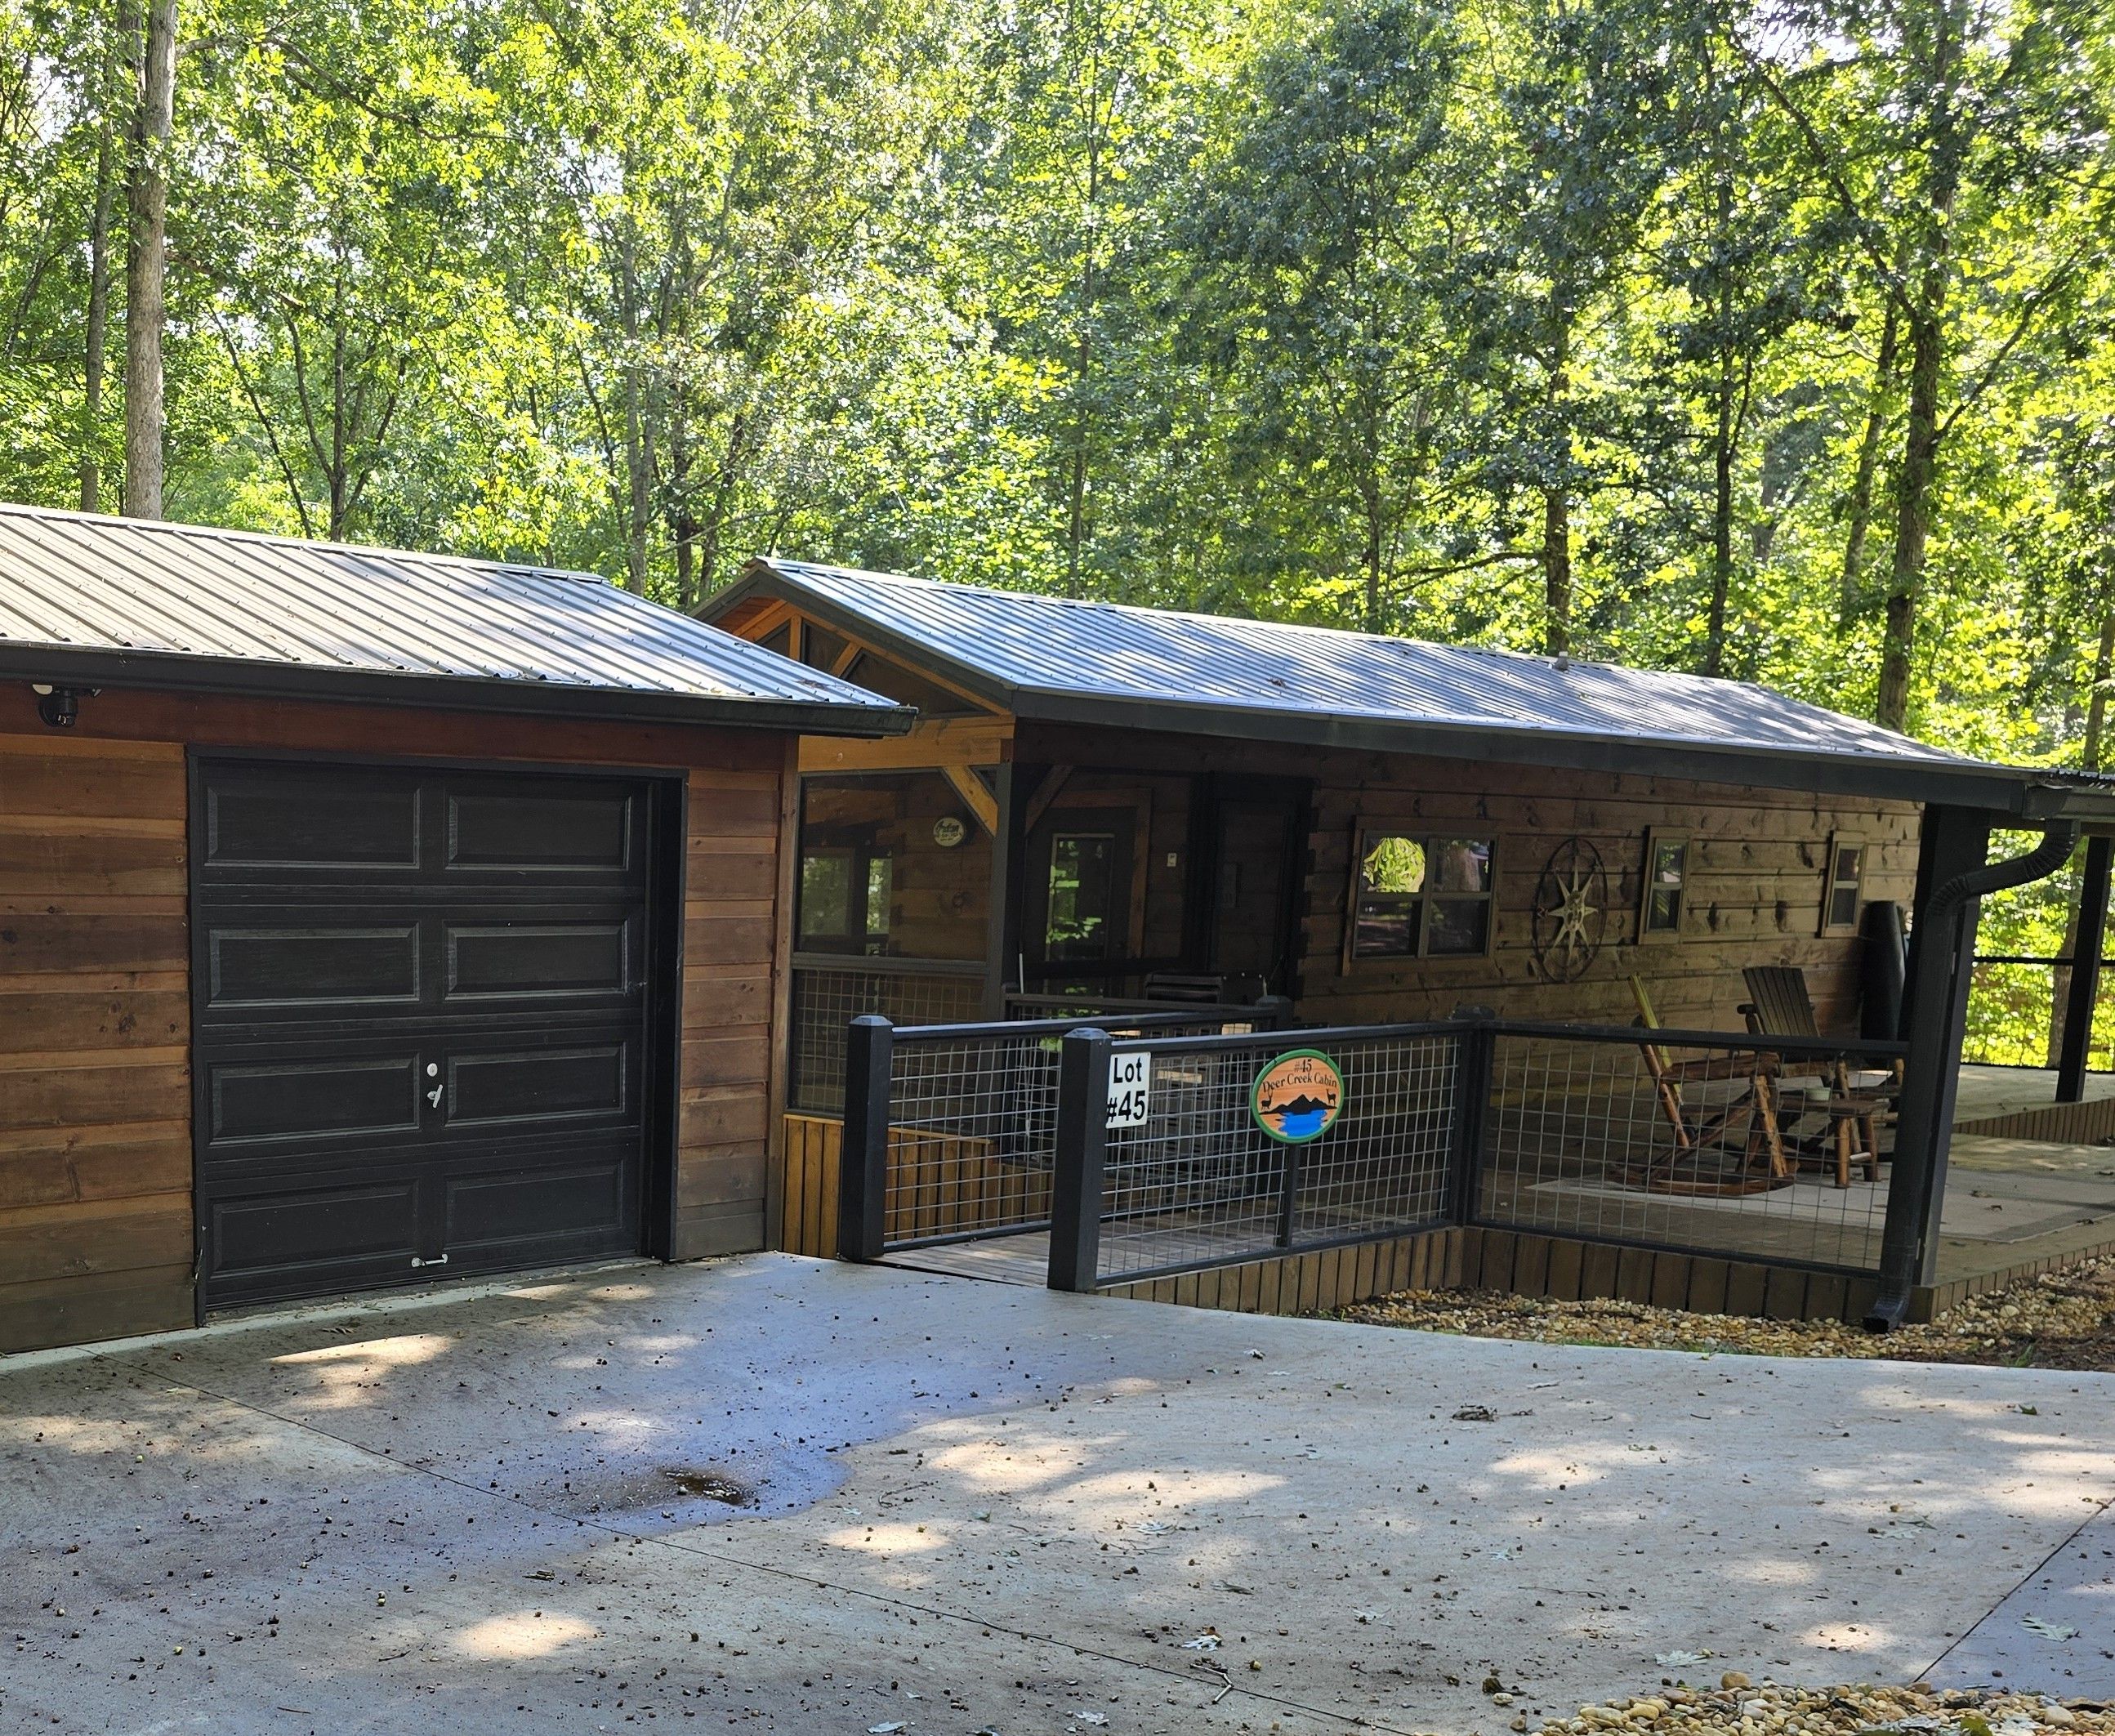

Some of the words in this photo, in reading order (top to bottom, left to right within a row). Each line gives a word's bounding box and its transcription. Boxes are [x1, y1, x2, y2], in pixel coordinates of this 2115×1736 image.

[1113, 1056, 1142, 1083] Lot
[1294, 1059, 1312, 1073] #45
[1262, 1078, 1285, 1093] Deer
[1287, 1073, 1312, 1085] Creek
[1314, 1072, 1337, 1088] Cabin
[1106, 1090, 1145, 1123] #45
